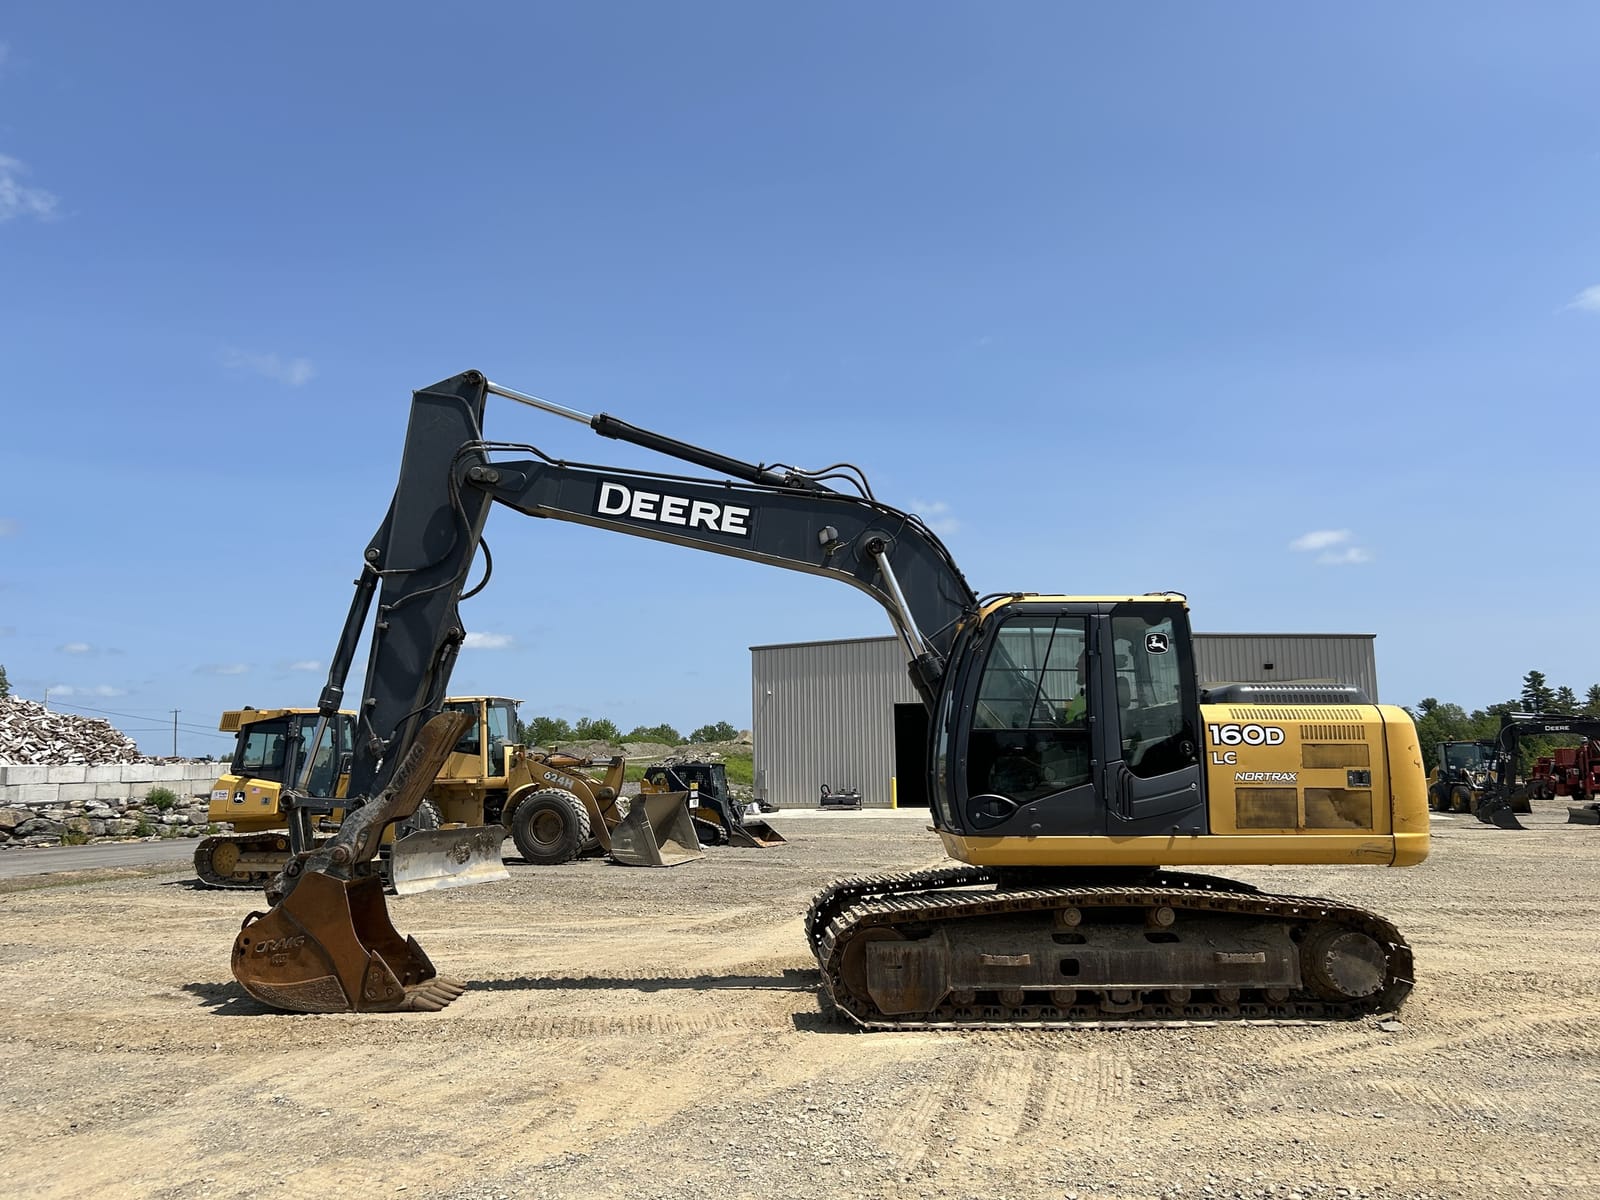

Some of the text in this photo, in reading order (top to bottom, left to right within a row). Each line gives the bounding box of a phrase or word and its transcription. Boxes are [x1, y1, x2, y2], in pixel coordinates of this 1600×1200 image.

[597, 481, 750, 535] DEERE
[1208, 723, 1285, 745] 160D
[1212, 751, 1237, 765] LC
[543, 771, 574, 790] 624H
[1234, 772, 1298, 782] NORTRAX
[255, 936, 305, 953] CRAIG
